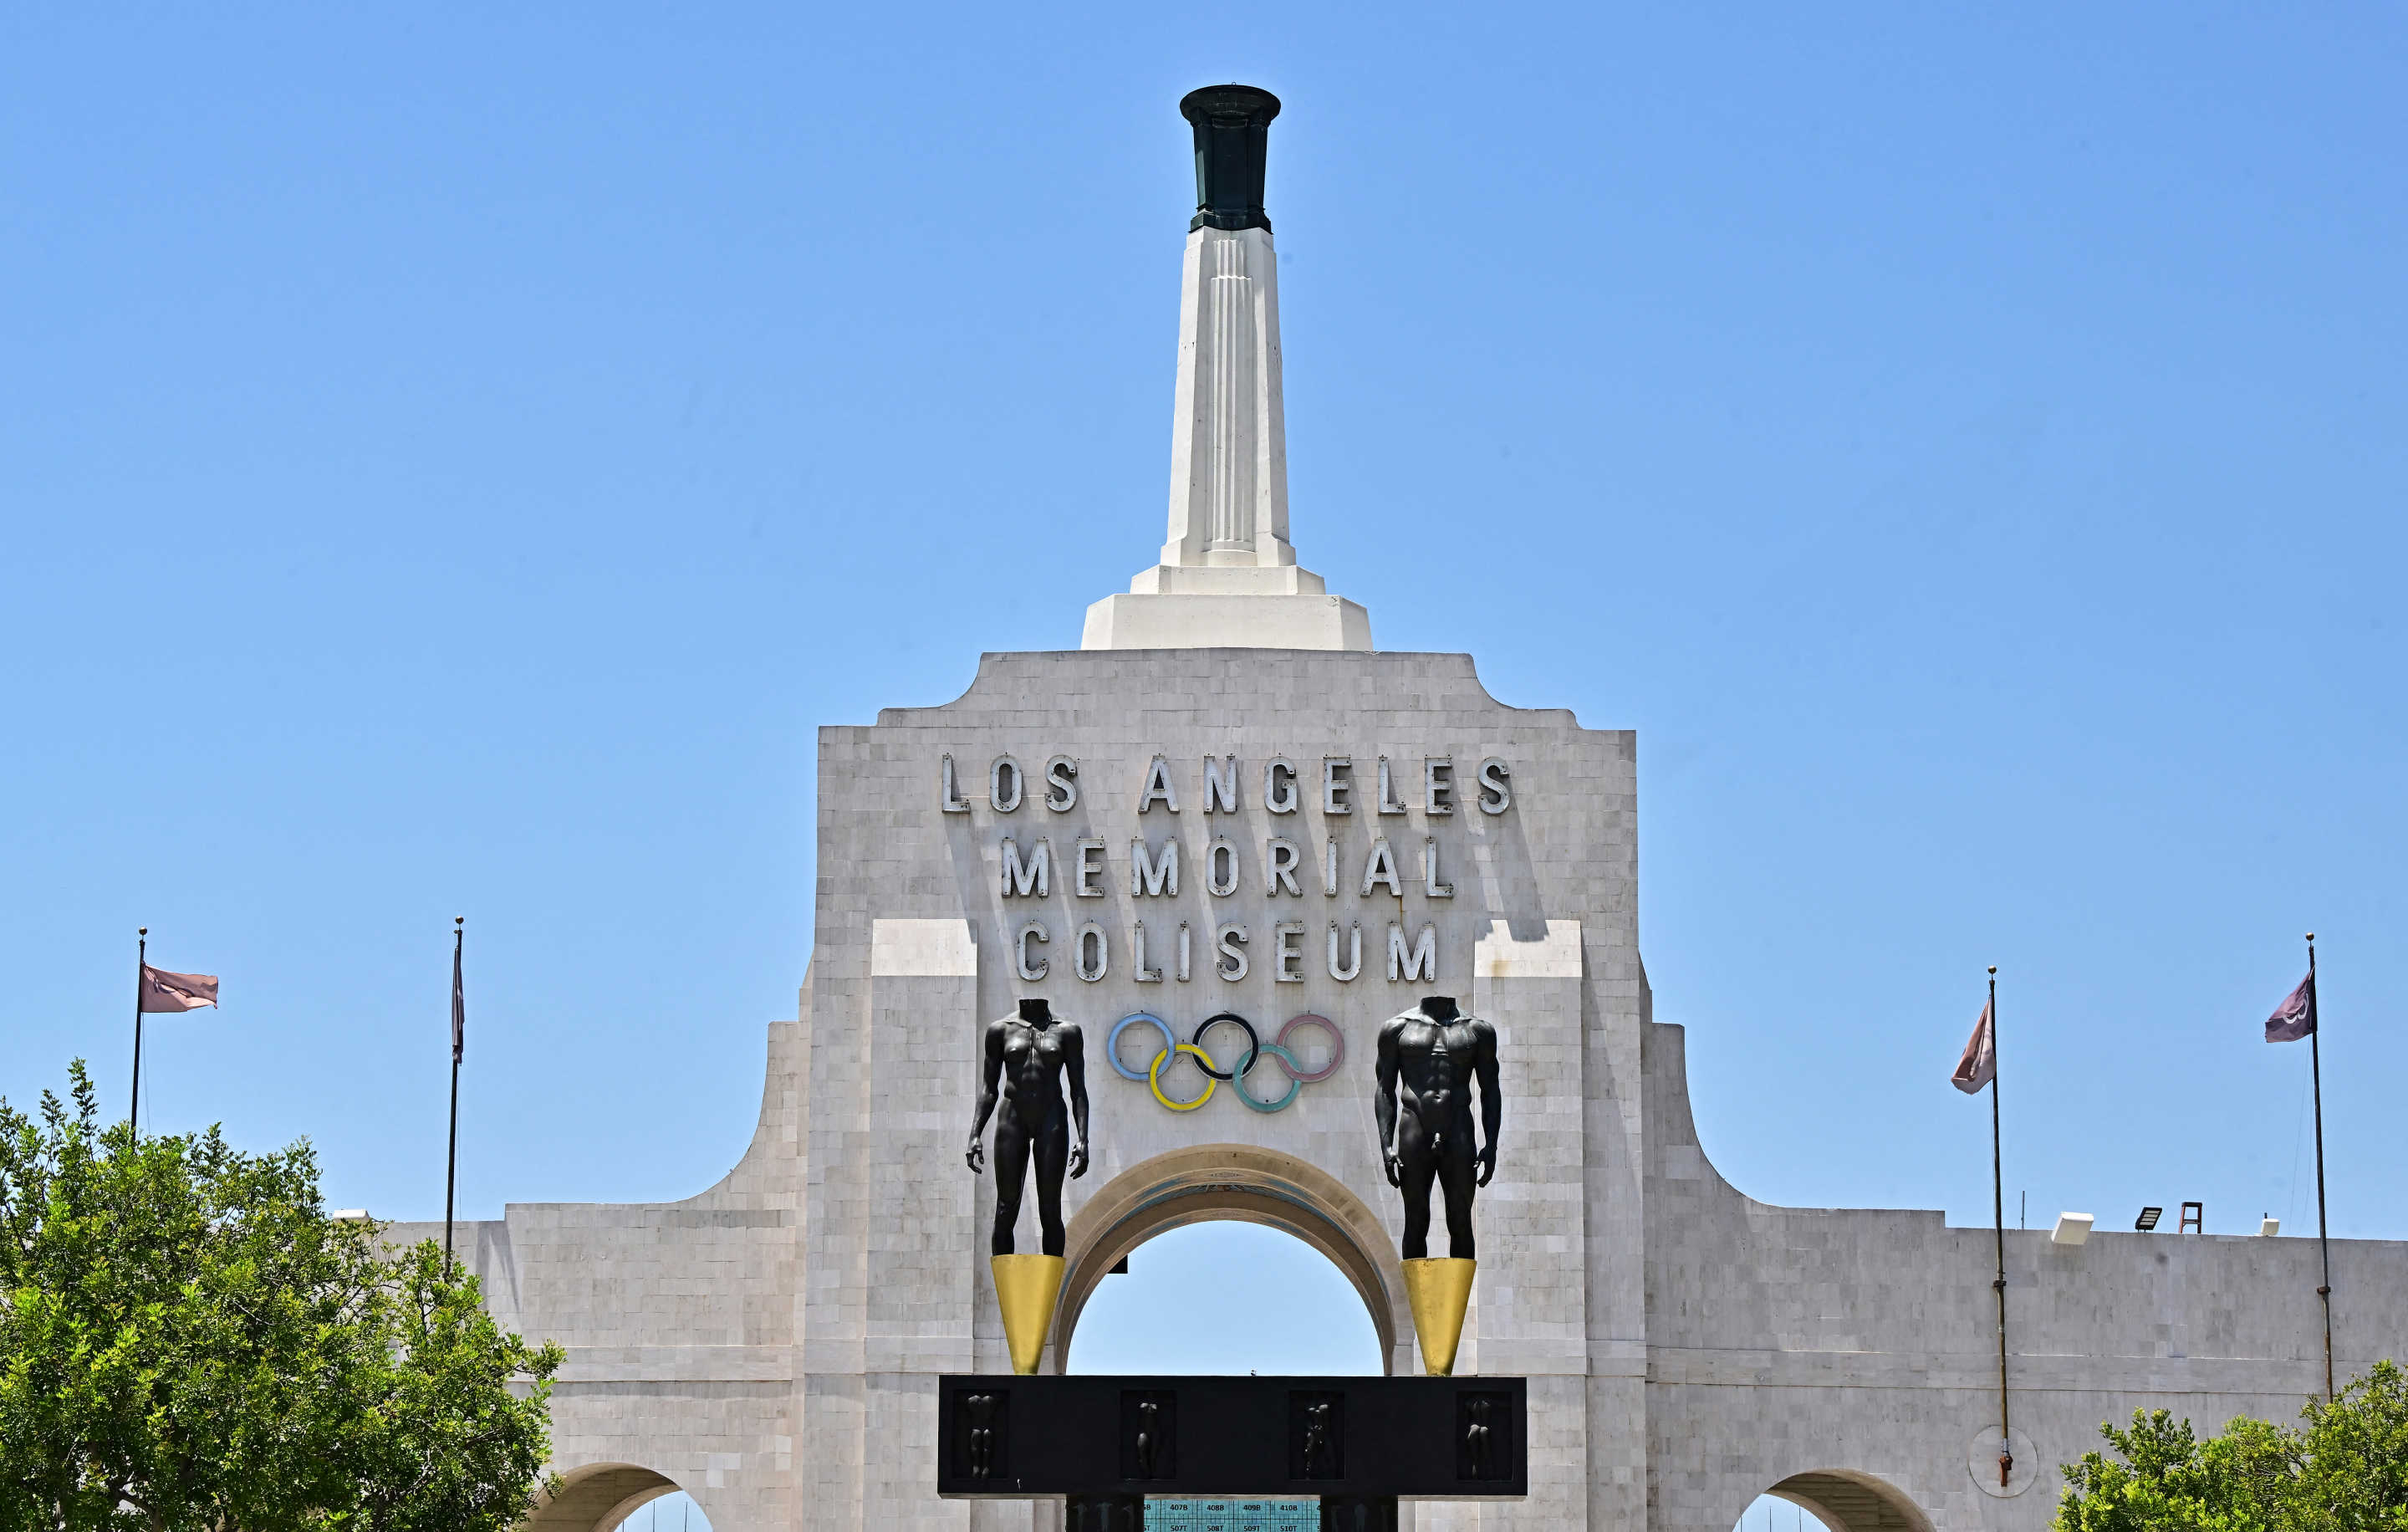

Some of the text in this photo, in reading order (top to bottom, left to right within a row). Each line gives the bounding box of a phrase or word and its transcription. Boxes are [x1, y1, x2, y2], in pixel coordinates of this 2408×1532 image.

[941, 753, 1510, 816] LOS ANGELES
[1002, 837, 1455, 898] MEMORIAL
[1015, 921, 1436, 983] COLISEUM
